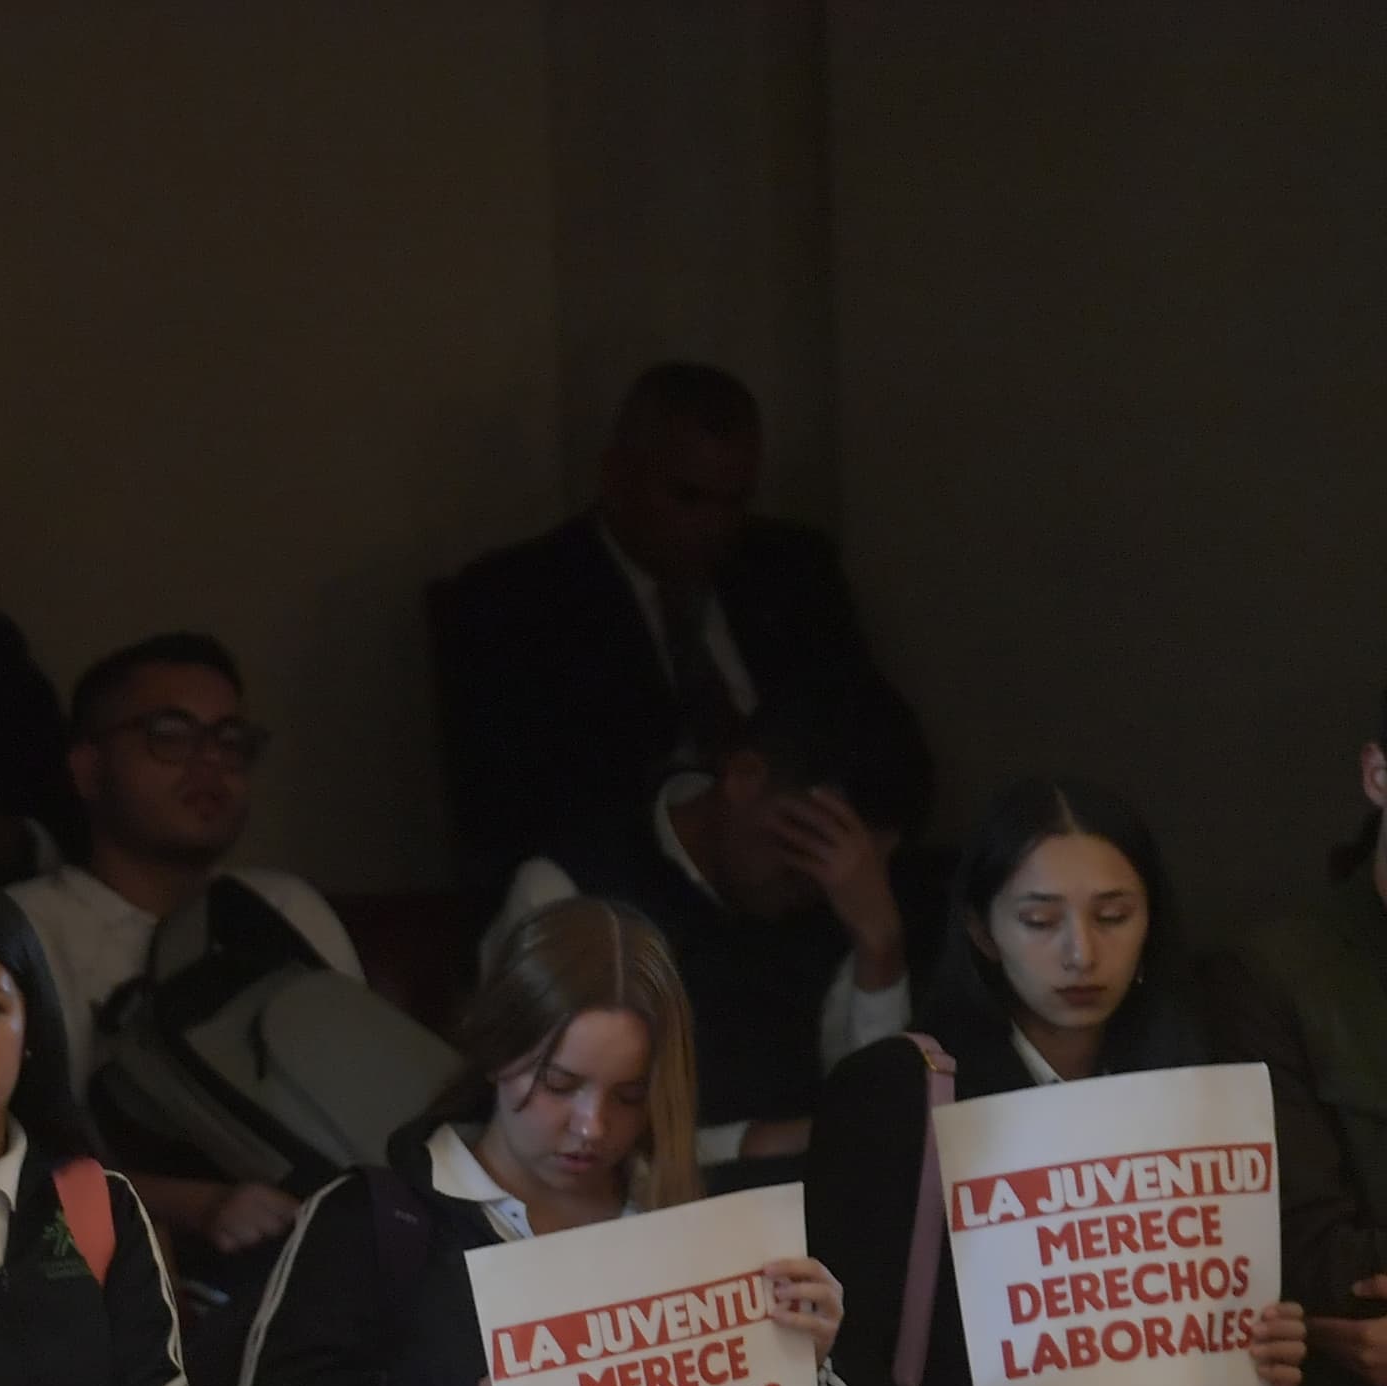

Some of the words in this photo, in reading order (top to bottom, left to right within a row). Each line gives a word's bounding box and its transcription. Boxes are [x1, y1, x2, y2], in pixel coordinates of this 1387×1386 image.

[958, 1184, 1026, 1228] LA
[1036, 1147, 1267, 1213] JUVENTUD
[1036, 1205, 1222, 1268] MERECE
[498, 1331, 566, 1376] LA
[577, 1275, 776, 1360] JUVENTU
[1006, 1255, 1250, 1326] DERECHOS
[1001, 1309, 1254, 1380] LABORALES
